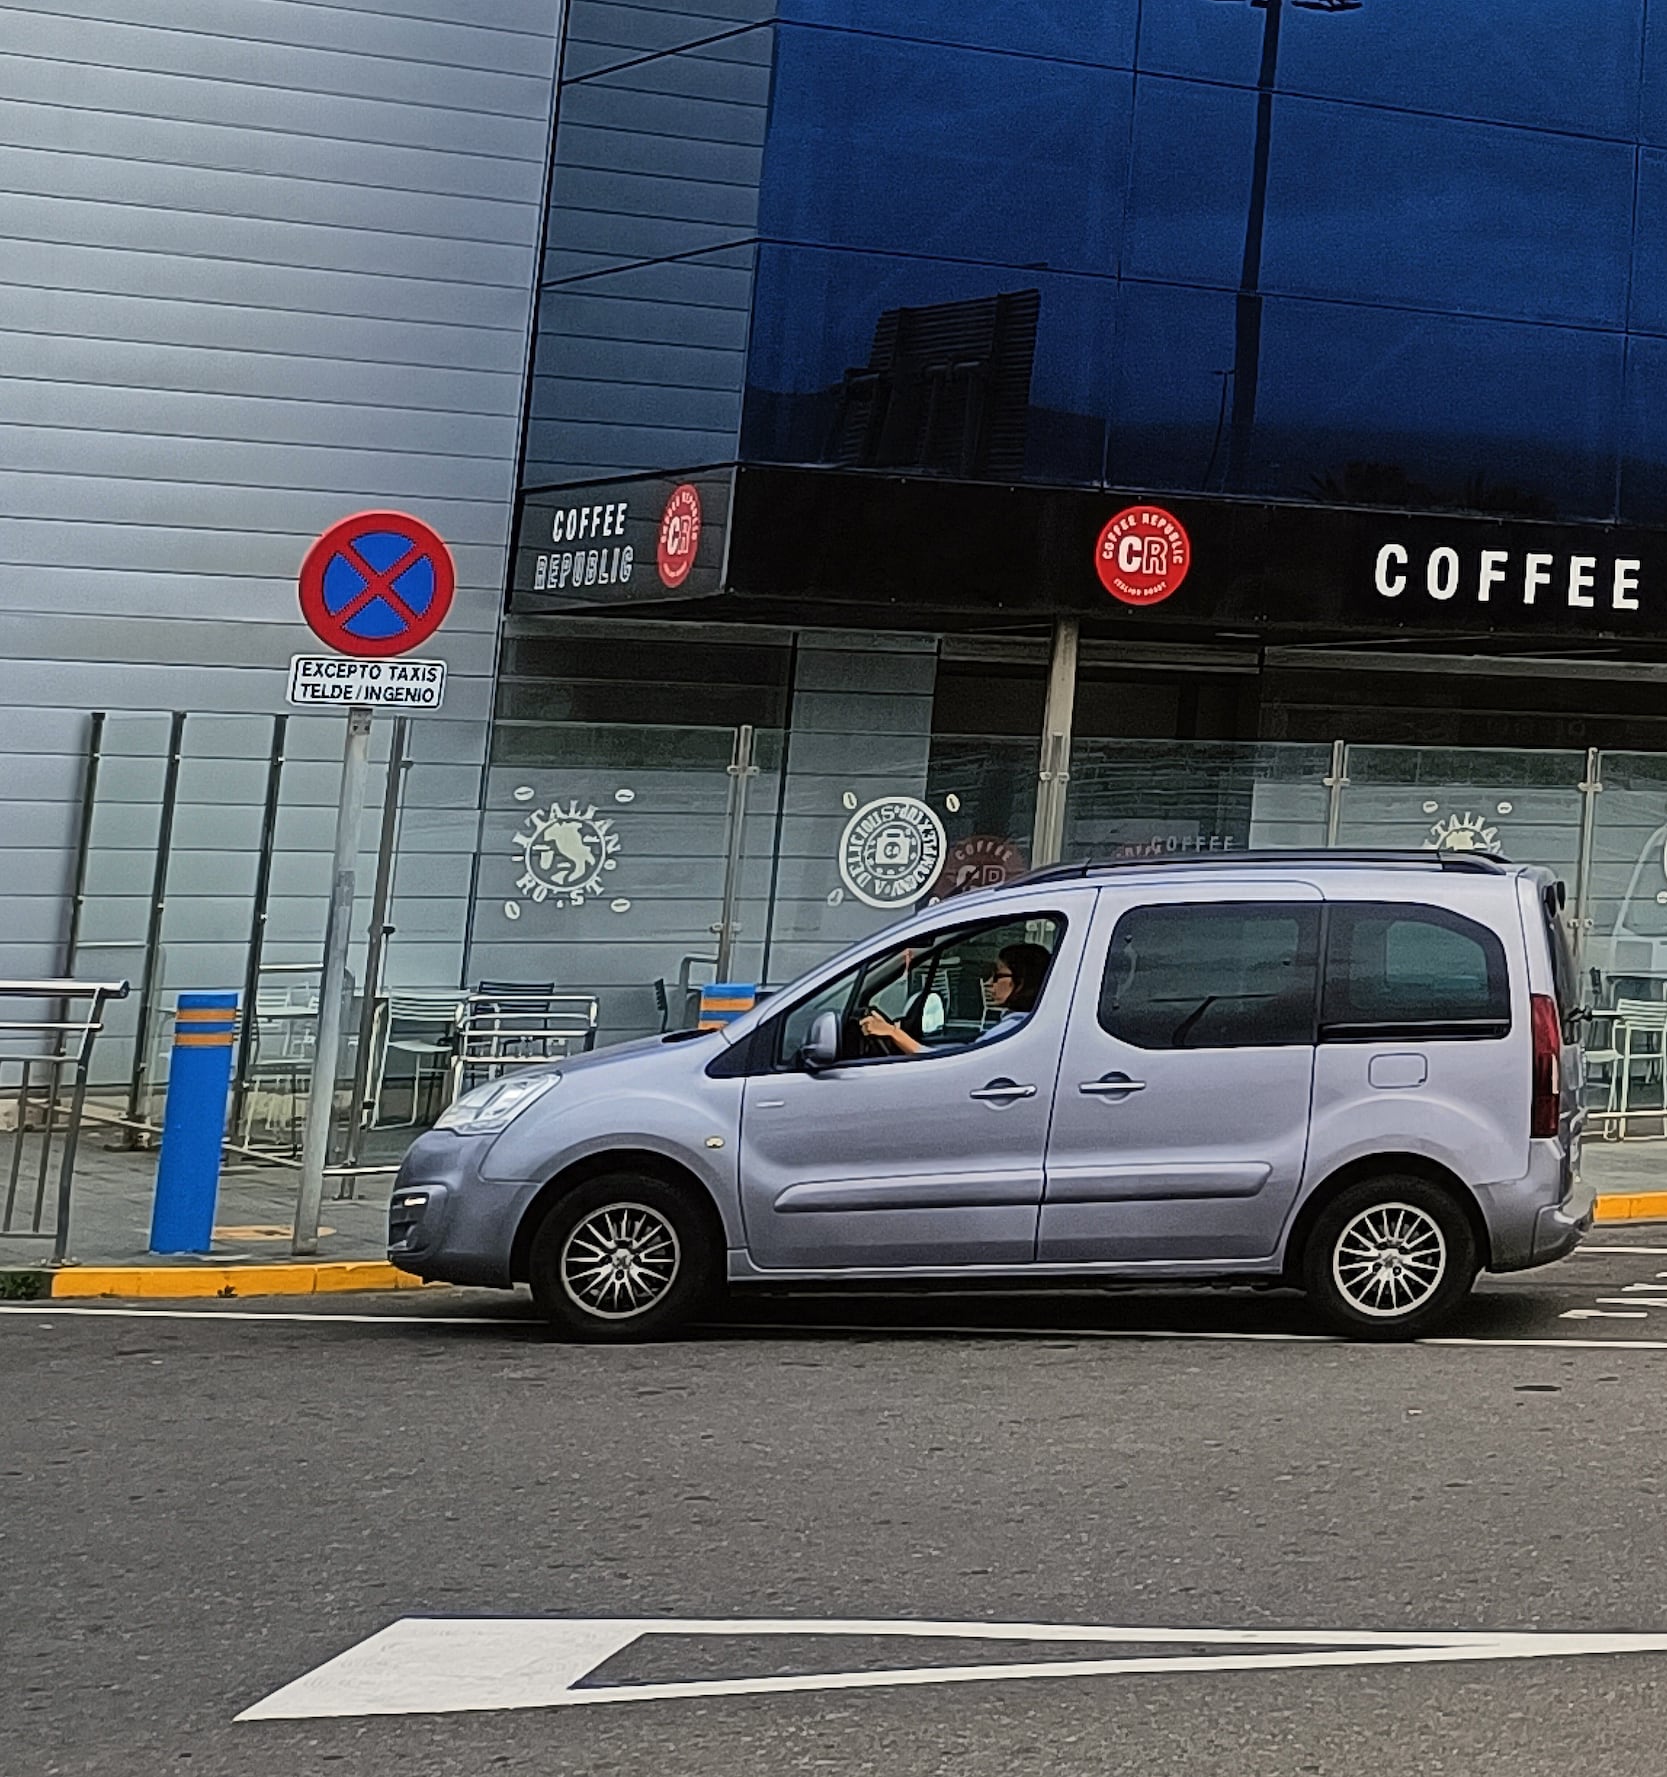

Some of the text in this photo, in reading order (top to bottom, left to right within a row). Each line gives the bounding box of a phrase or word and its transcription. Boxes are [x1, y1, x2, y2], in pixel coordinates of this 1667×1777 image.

[552, 502, 628, 542] COFFEE
[533, 545, 634, 591] REPUBLIC
[1118, 535, 1167, 576] CR
[1374, 543, 1642, 610] COFFEE
[301, 661, 438, 683] EXCEPTO TAXIS
[511, 799, 621, 854] ITALIAN
[847, 805, 896, 888] DELICIOUS
[1151, 835, 1234, 853] COFFEE
[954, 840, 1013, 862] COFFEE
